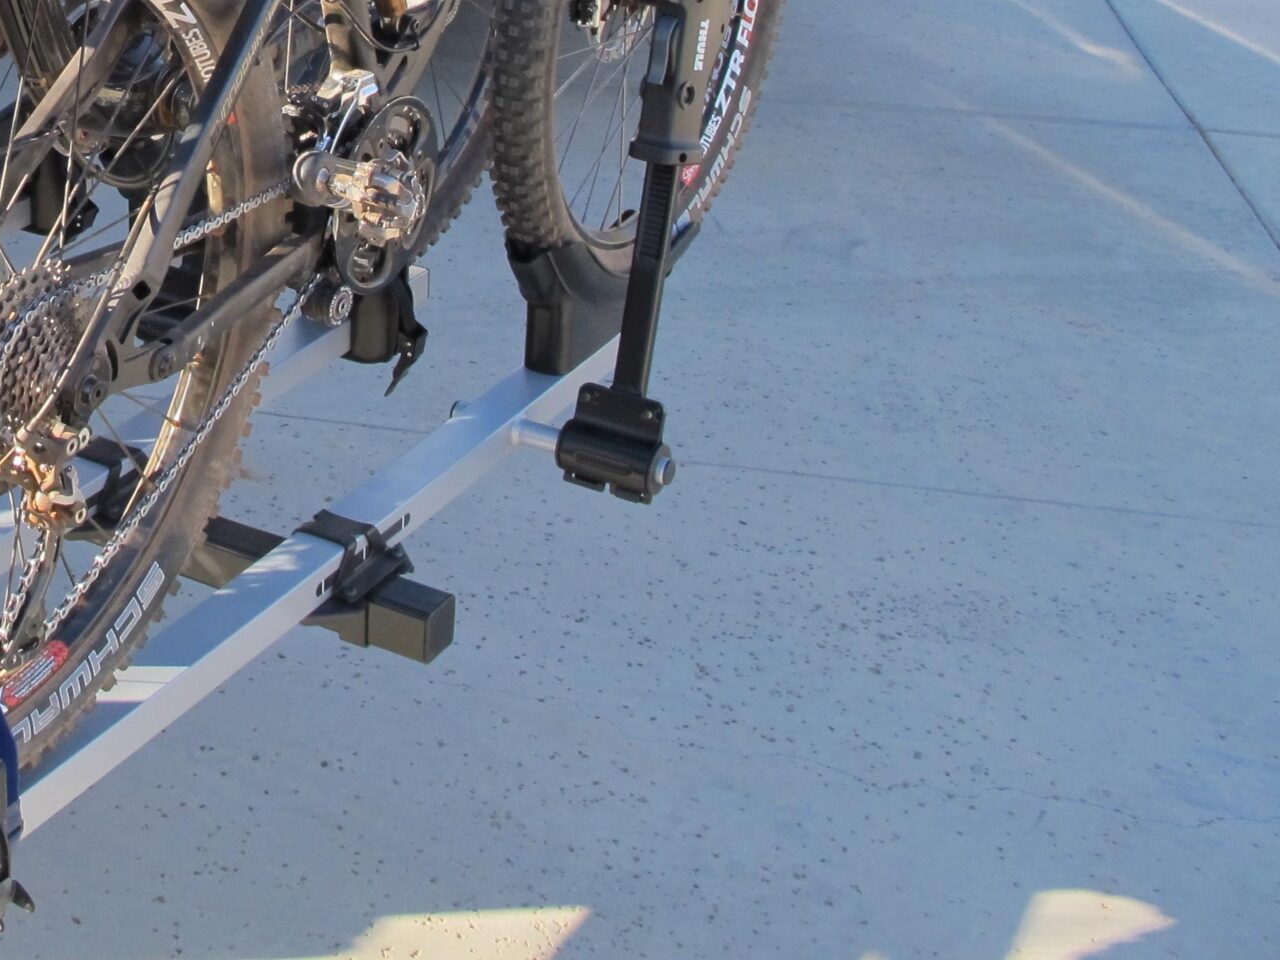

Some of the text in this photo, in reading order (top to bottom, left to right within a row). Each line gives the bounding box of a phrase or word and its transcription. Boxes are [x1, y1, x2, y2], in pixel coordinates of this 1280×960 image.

[180, 28, 216, 83] OTUBES
[693, 18, 710, 72] THULE
[714, 48, 746, 118] ZTR
